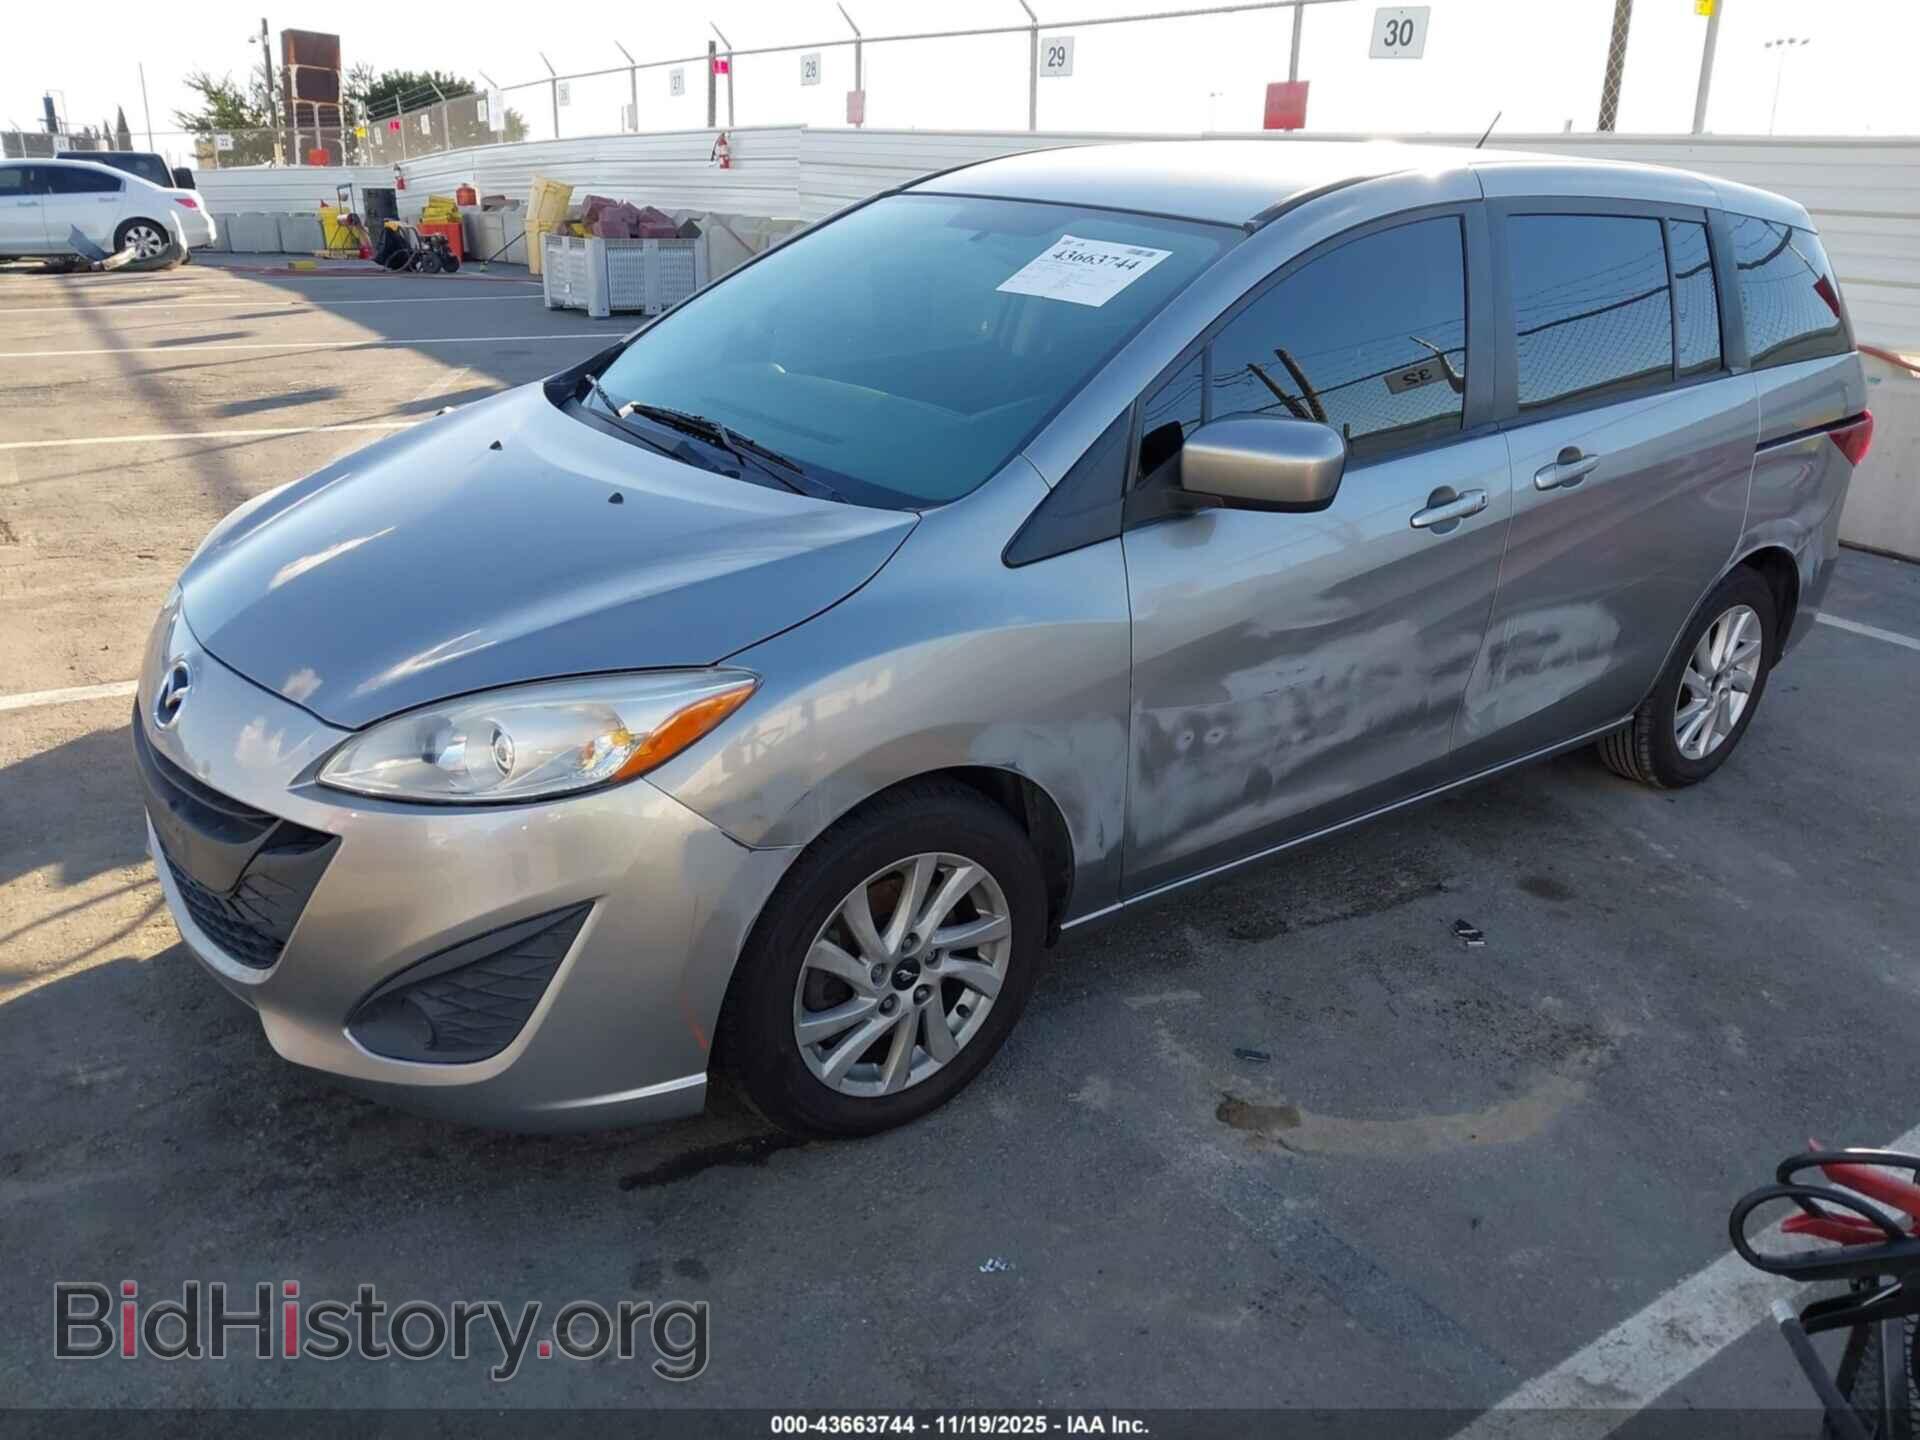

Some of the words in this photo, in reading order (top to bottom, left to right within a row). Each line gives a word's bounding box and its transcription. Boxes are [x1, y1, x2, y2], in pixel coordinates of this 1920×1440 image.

[1383, 18, 1414, 47] 30
[1047, 46, 1066, 67] 29
[805, 60, 817, 78] 28
[1052, 249, 1142, 271] 43663744
